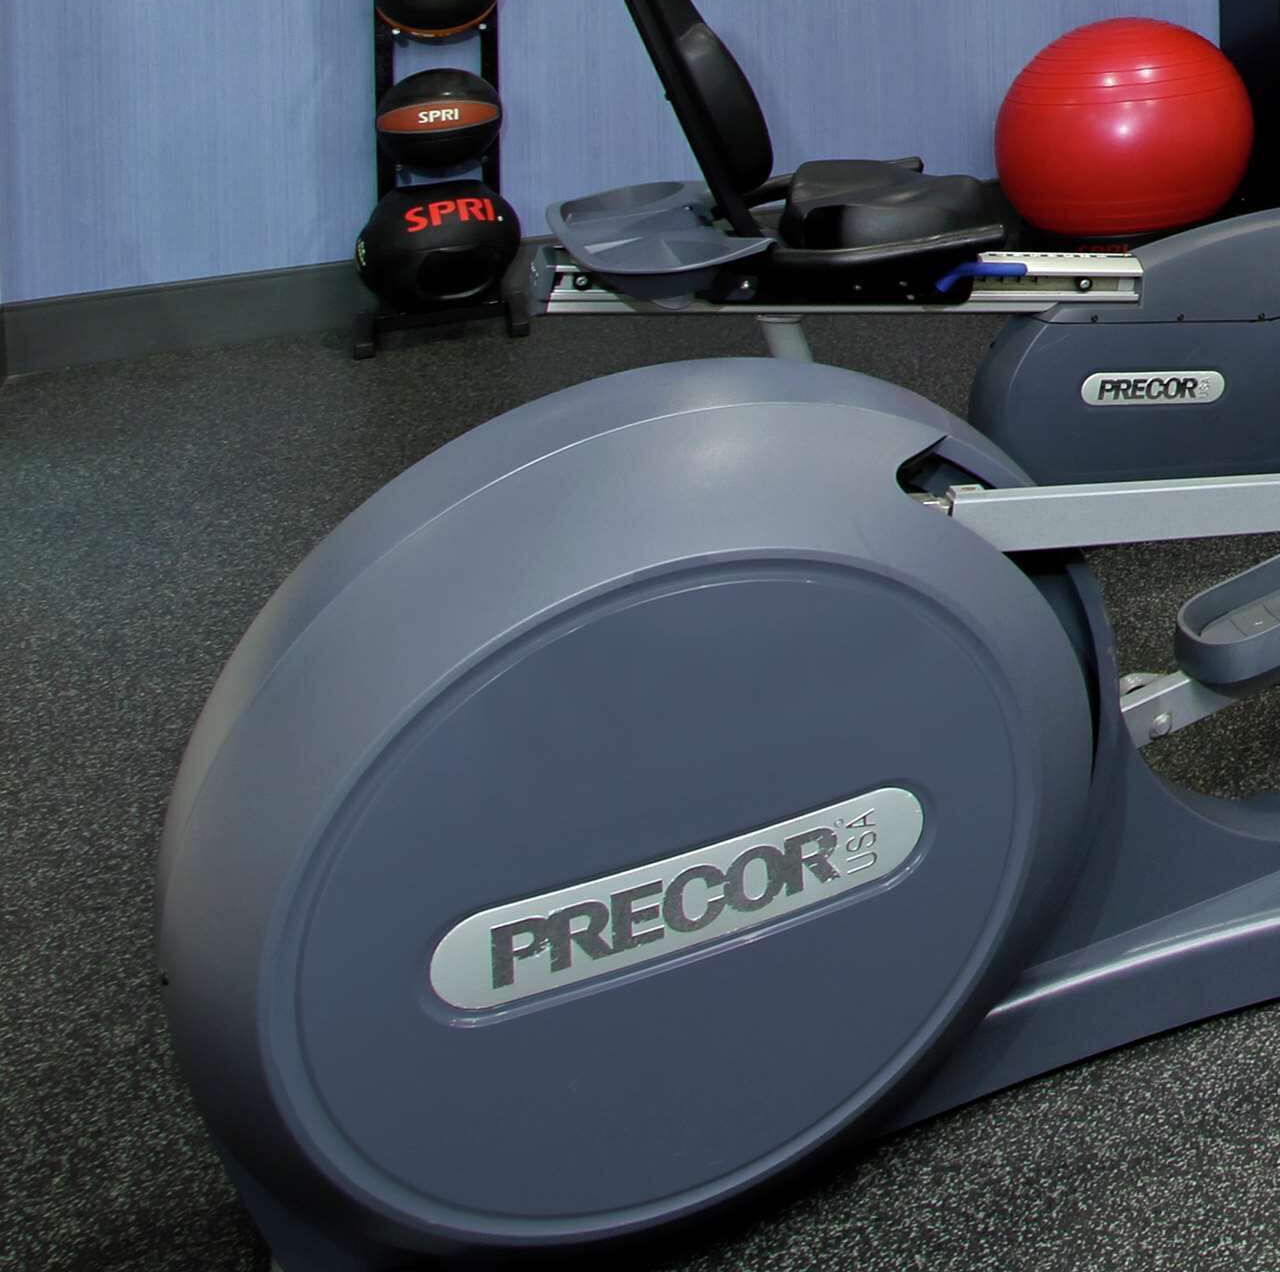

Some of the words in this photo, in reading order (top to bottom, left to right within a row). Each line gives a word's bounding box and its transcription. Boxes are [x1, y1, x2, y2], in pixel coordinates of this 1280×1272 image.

[418, 108, 459, 123] SPRI
[404, 197, 496, 233] SPRI
[1097, 377, 1198, 400] PRECOR
[845, 807, 877, 876] USA
[490, 825, 842, 990] PRECOR
